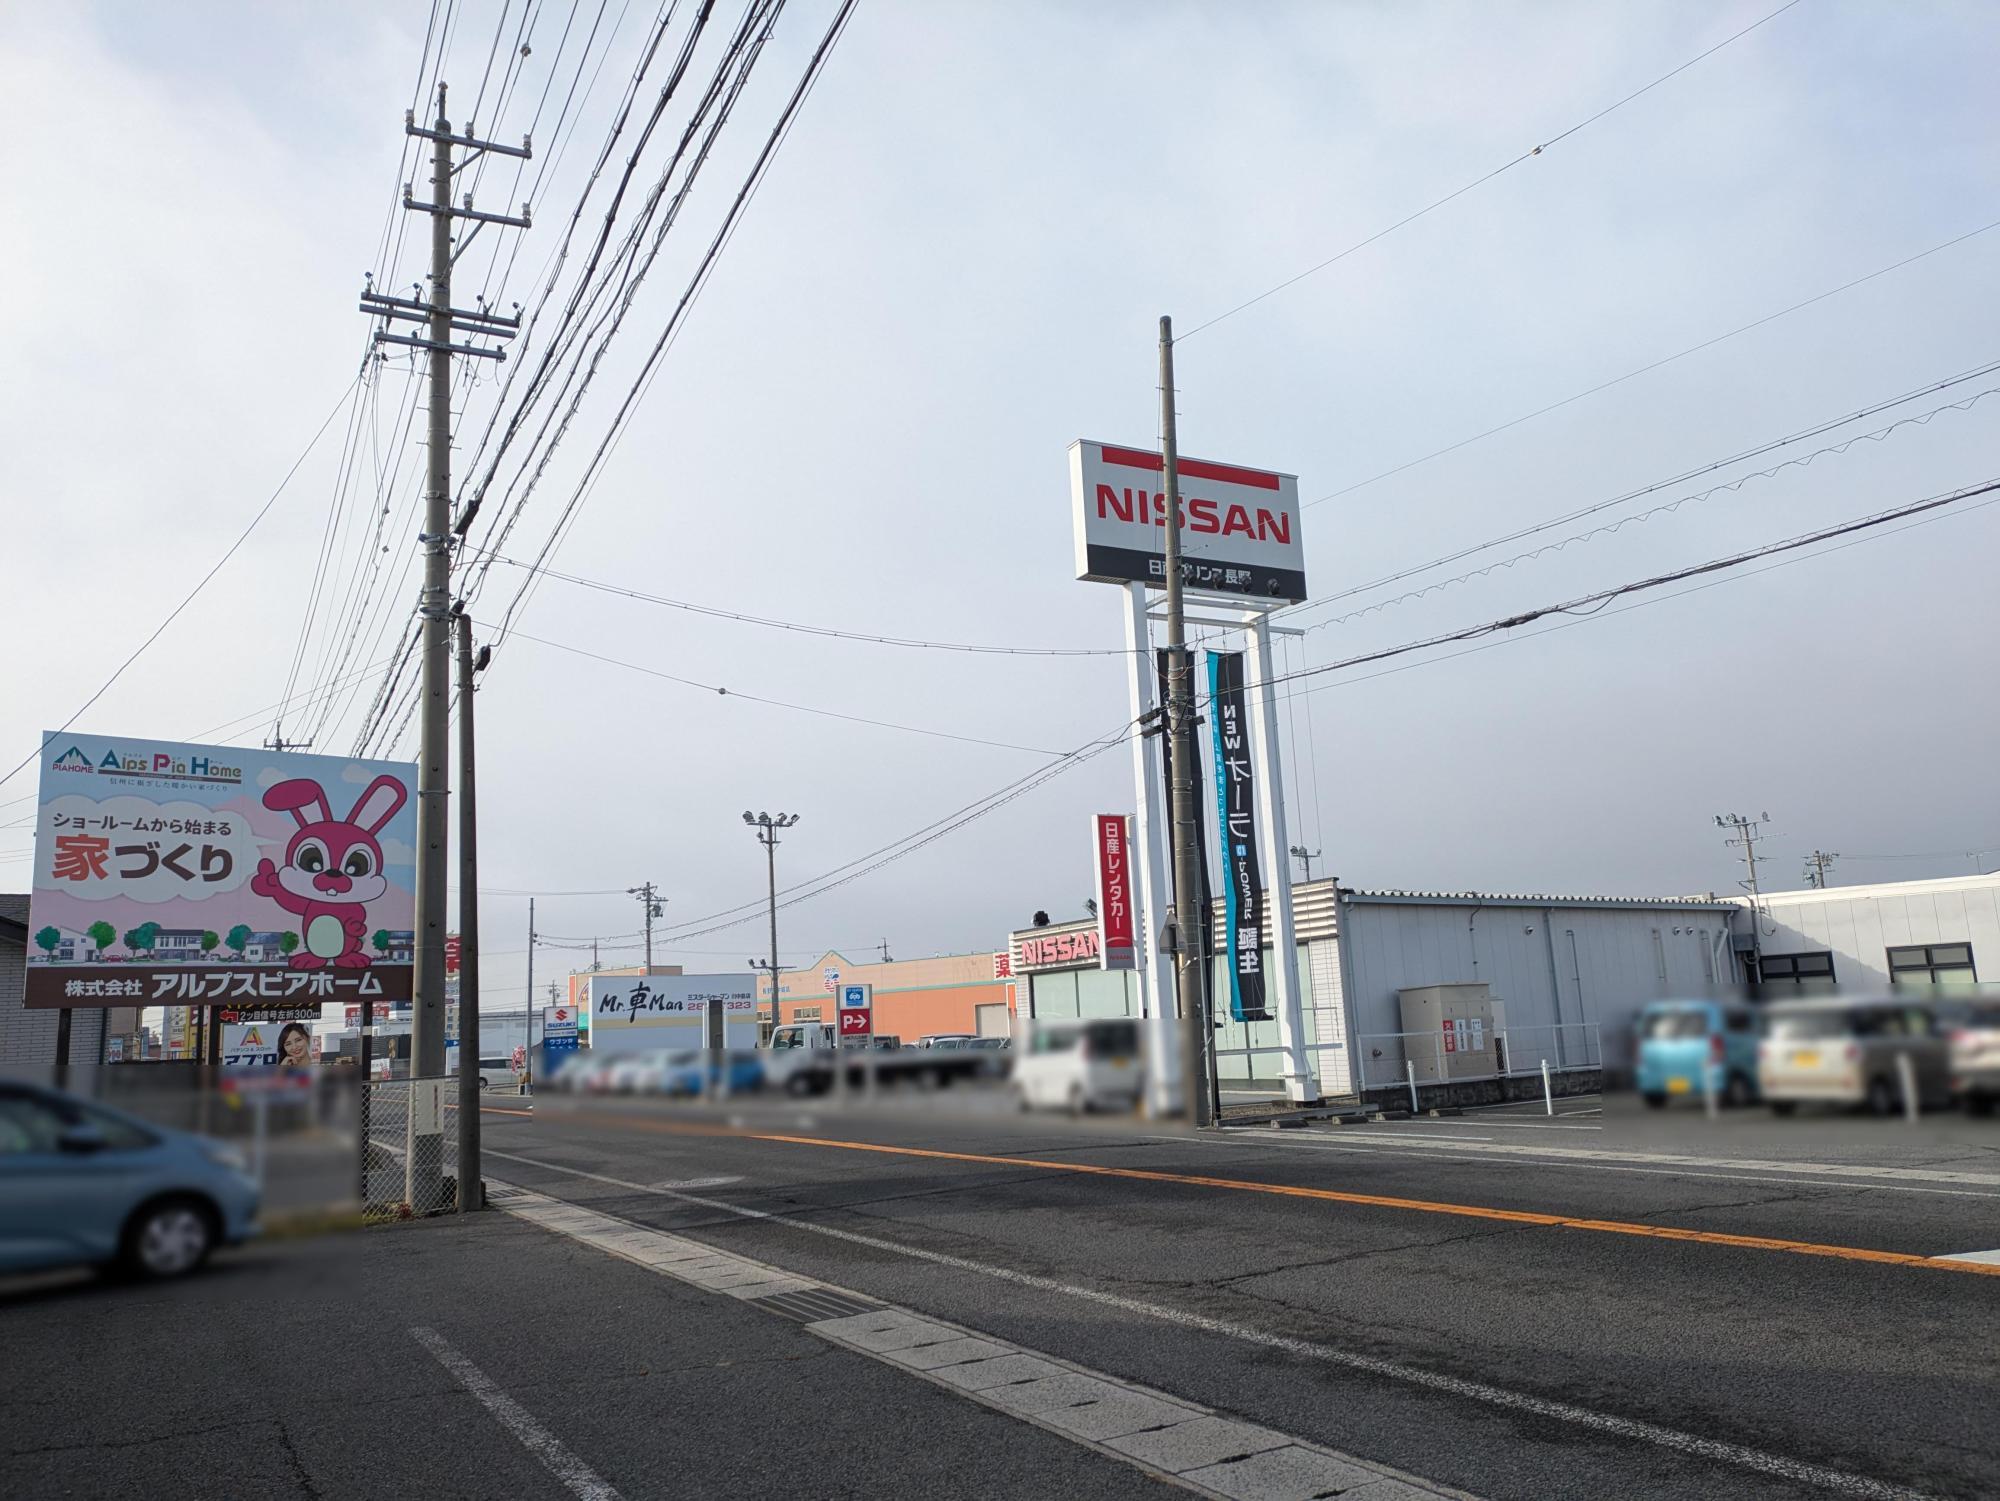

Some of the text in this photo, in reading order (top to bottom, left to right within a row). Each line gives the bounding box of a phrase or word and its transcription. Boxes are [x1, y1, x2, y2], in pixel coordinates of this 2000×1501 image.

[1096, 484, 1291, 545] NISSAN
[100, 749, 242, 778] Alps Pia Home
[53, 812, 232, 836] ショールームから始まる
[52, 833, 233, 882] 家づくり
[1105, 822, 1124, 929] 日産レンタカー
[1021, 931, 1100, 966] NISSAN
[65, 970, 383, 998] 株式会社 アルプスピアホーム
[843, 1015, 854, 1029] P
